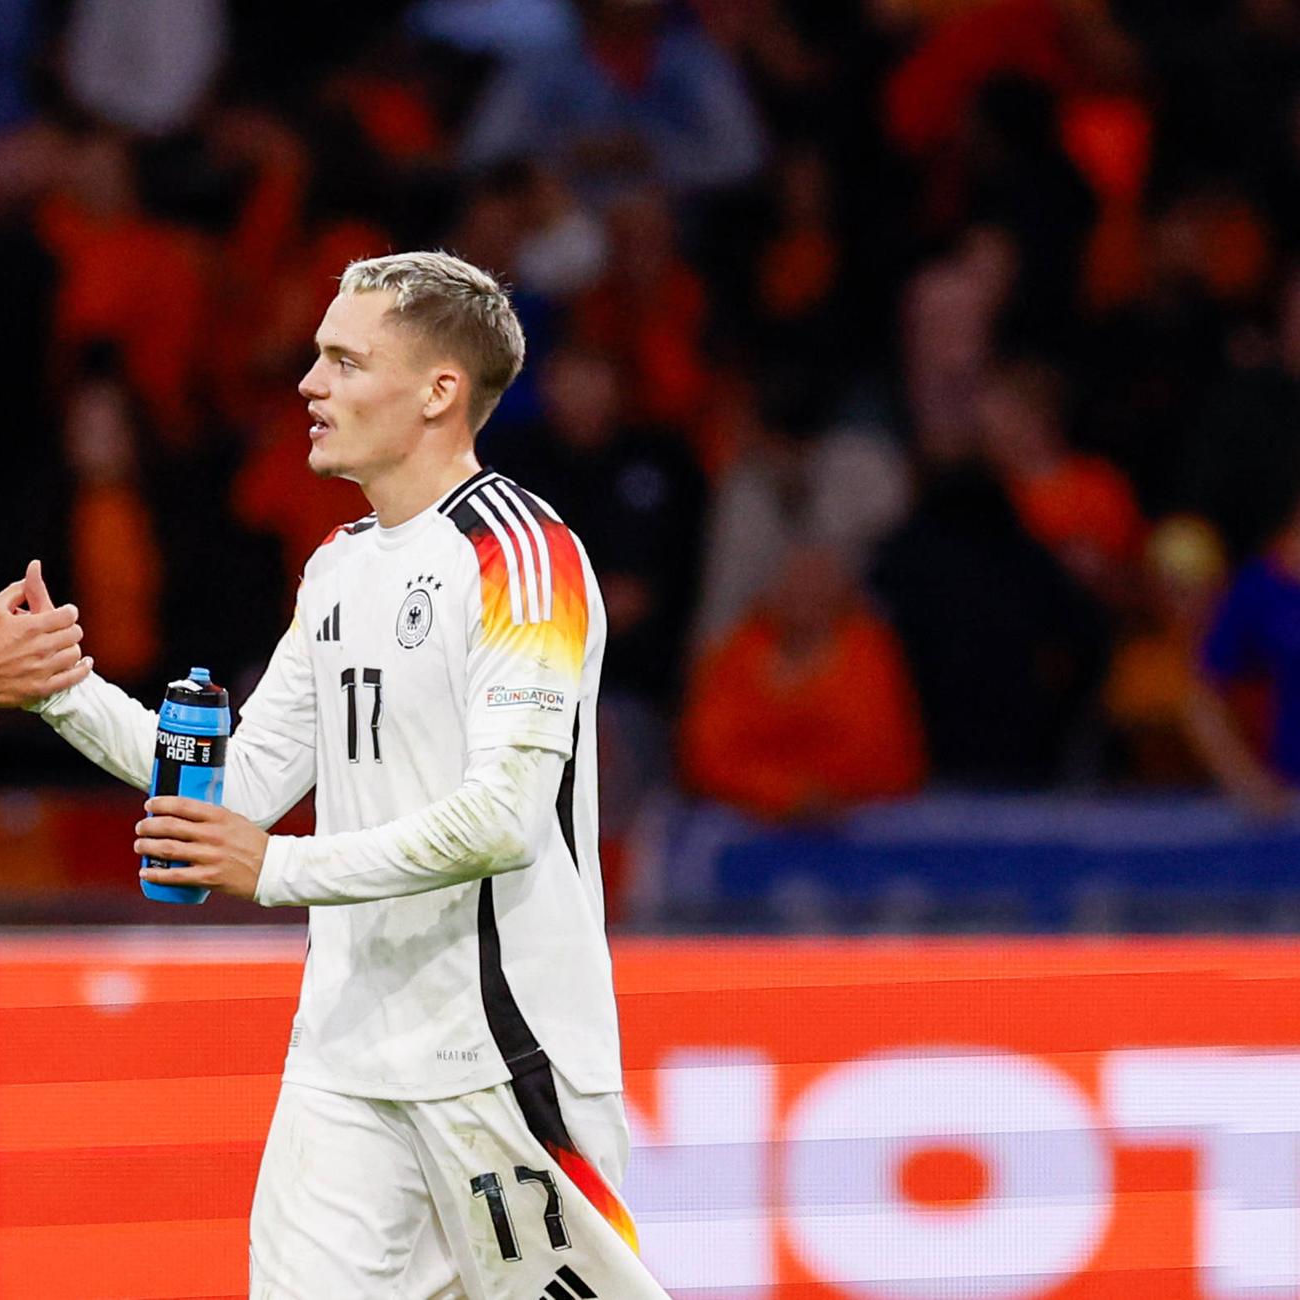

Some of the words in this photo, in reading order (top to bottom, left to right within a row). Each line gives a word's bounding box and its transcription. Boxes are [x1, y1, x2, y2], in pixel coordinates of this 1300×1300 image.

[341, 667, 384, 764] 17
[487, 691, 564, 704] FOUNDATION
[166, 746, 196, 762] ADE
[469, 1165, 572, 1262] 17
